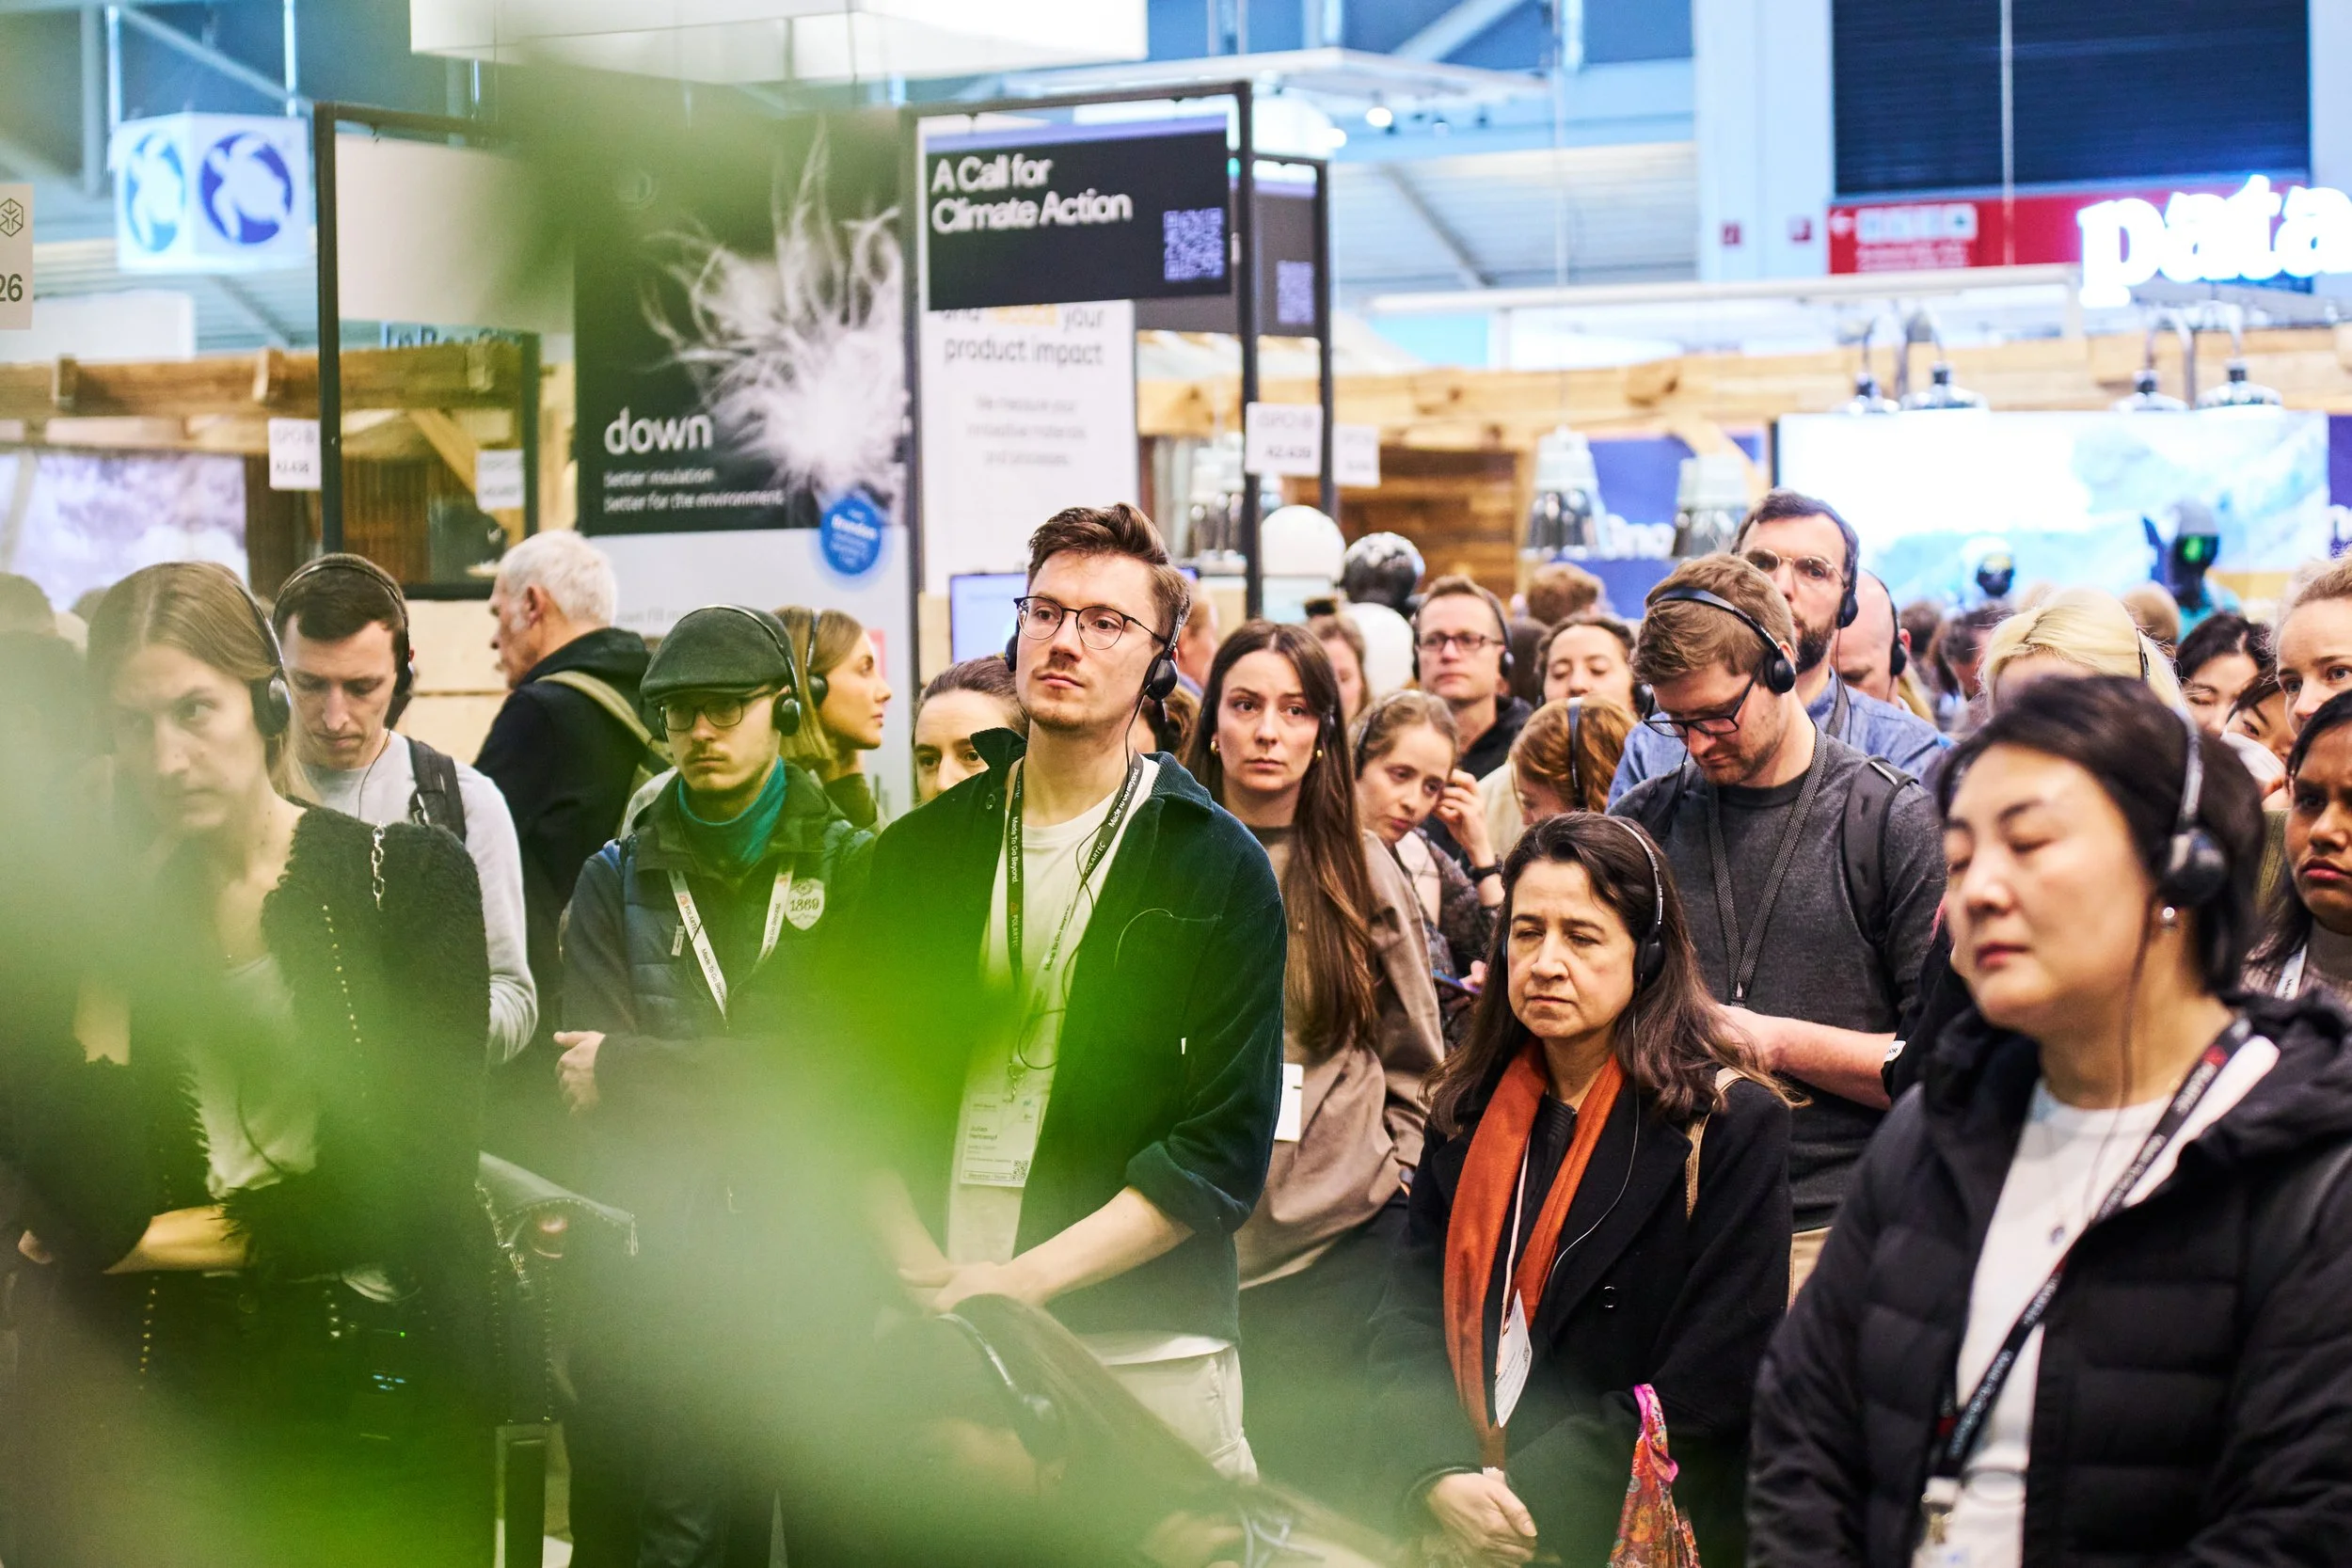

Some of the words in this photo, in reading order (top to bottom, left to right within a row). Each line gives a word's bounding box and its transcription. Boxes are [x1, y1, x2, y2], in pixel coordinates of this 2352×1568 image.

[930, 159, 956, 194] A
[957, 154, 1010, 193] Call
[1011, 153, 1054, 188] for
[931, 198, 1040, 234] Climate
[1039, 188, 1134, 227] Action
[1061, 305, 1105, 332] your
[944, 333, 1027, 366] product
[1031, 333, 1104, 371] impact
[604, 406, 713, 455] down
[1010, 816, 1019, 836] Made
[1108, 807, 1122, 828] Made
[1010, 847, 1019, 856] Go
